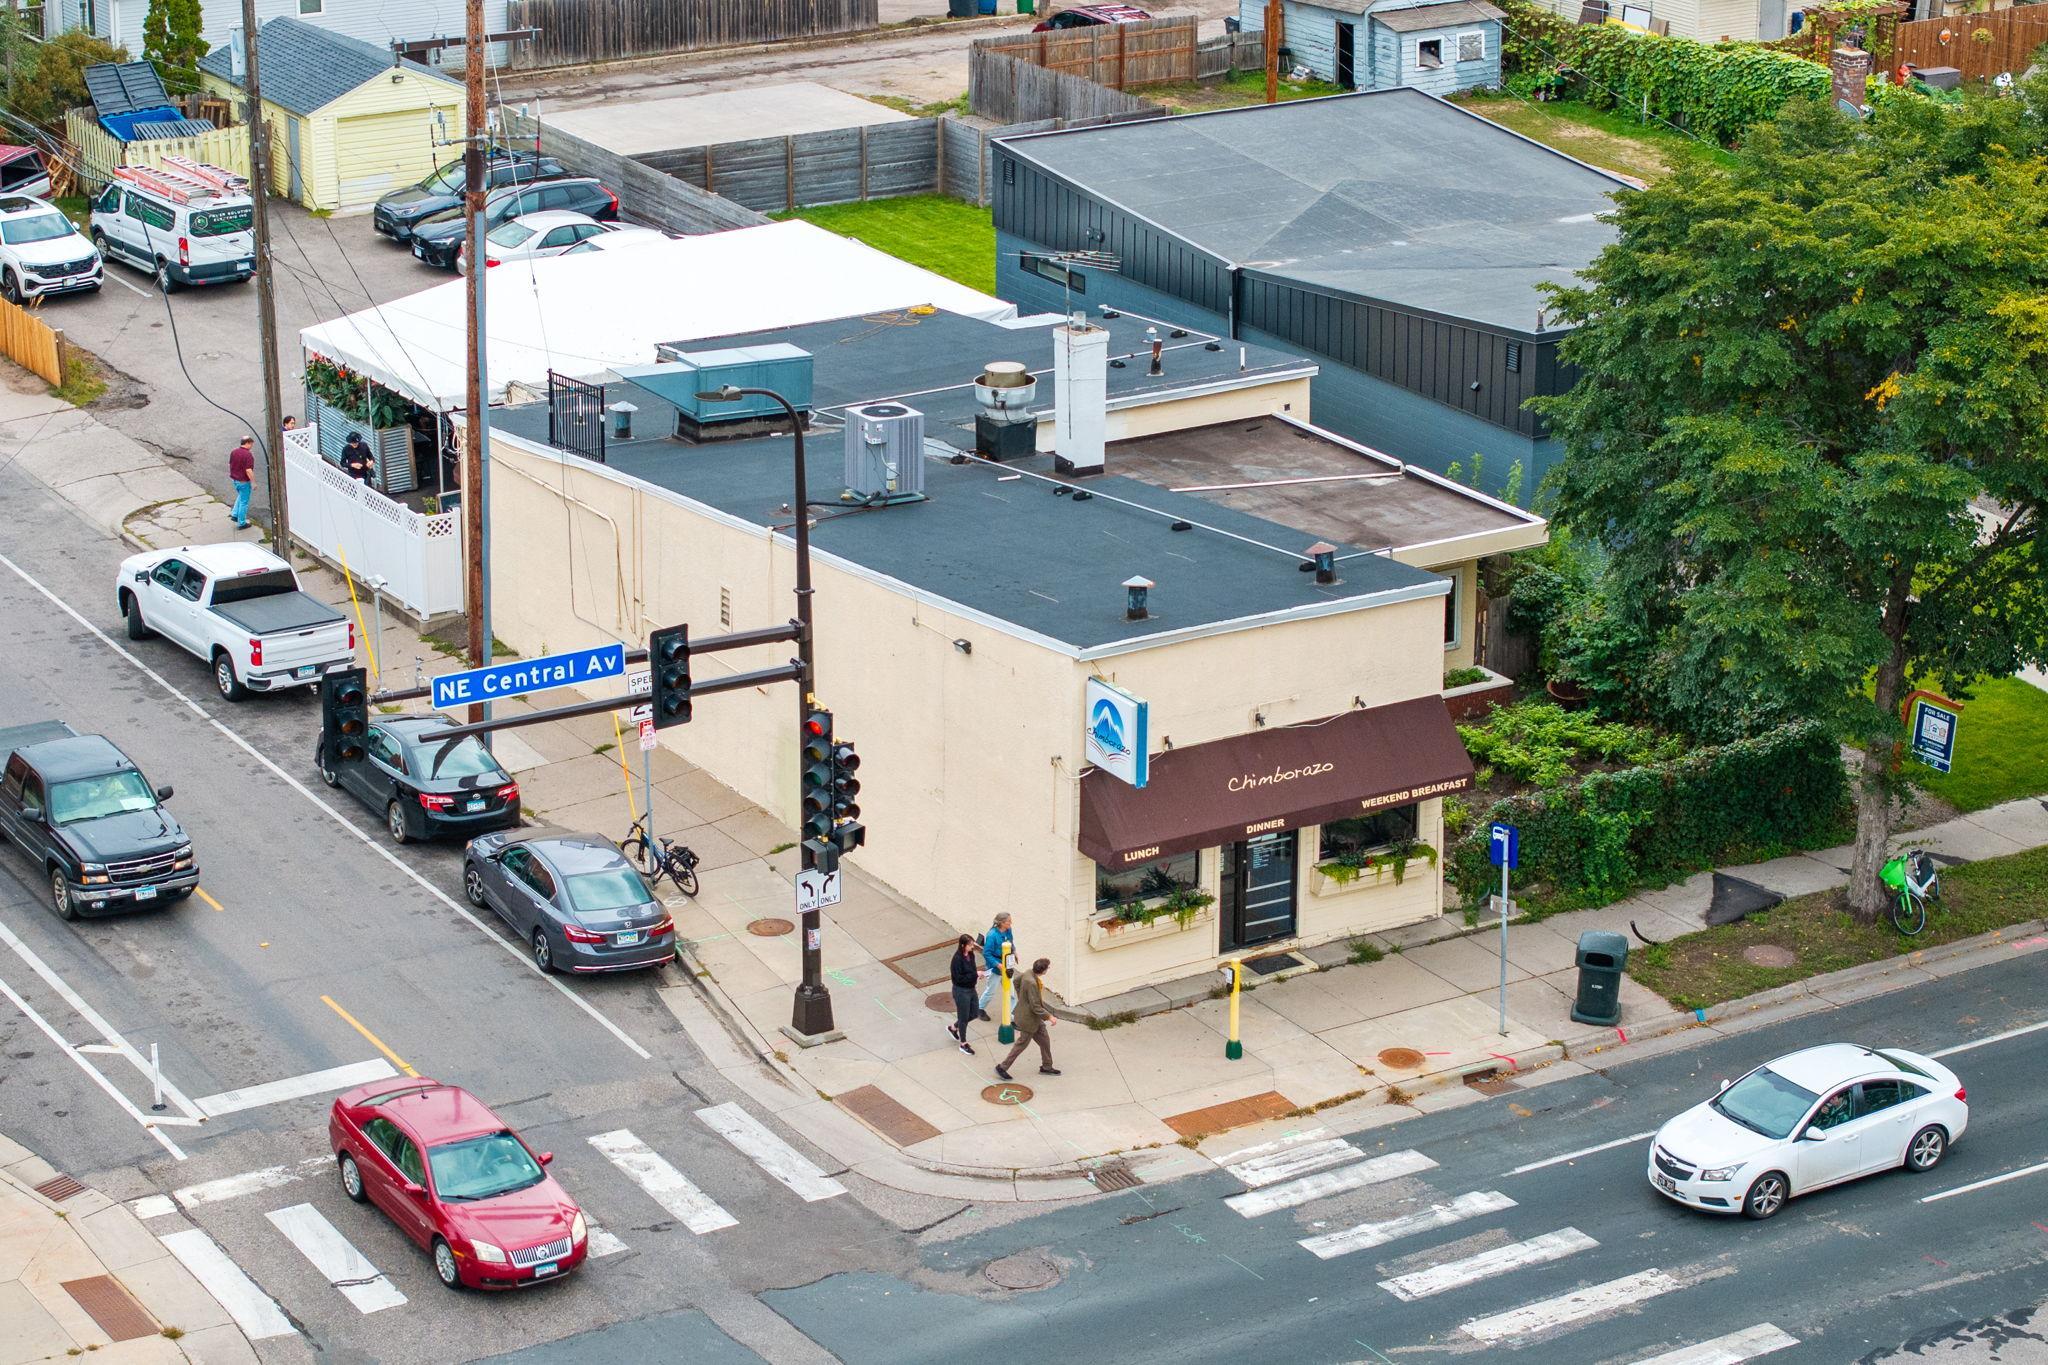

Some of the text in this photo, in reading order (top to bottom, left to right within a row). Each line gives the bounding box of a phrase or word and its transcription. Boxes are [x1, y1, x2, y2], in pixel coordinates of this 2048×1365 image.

[440, 655, 617, 701] NE Central Av
[631, 675, 652, 687] SPEE
[1924, 707, 1950, 721] FOR SALE
[1228, 763, 1334, 792] Chimborazo
[1361, 778, 1468, 809] WEEKEND BREAKFAST
[1246, 818, 1285, 834] DINNER
[1124, 847, 1160, 862] LUNCH
[800, 895, 837, 910] ONLY ONLY
